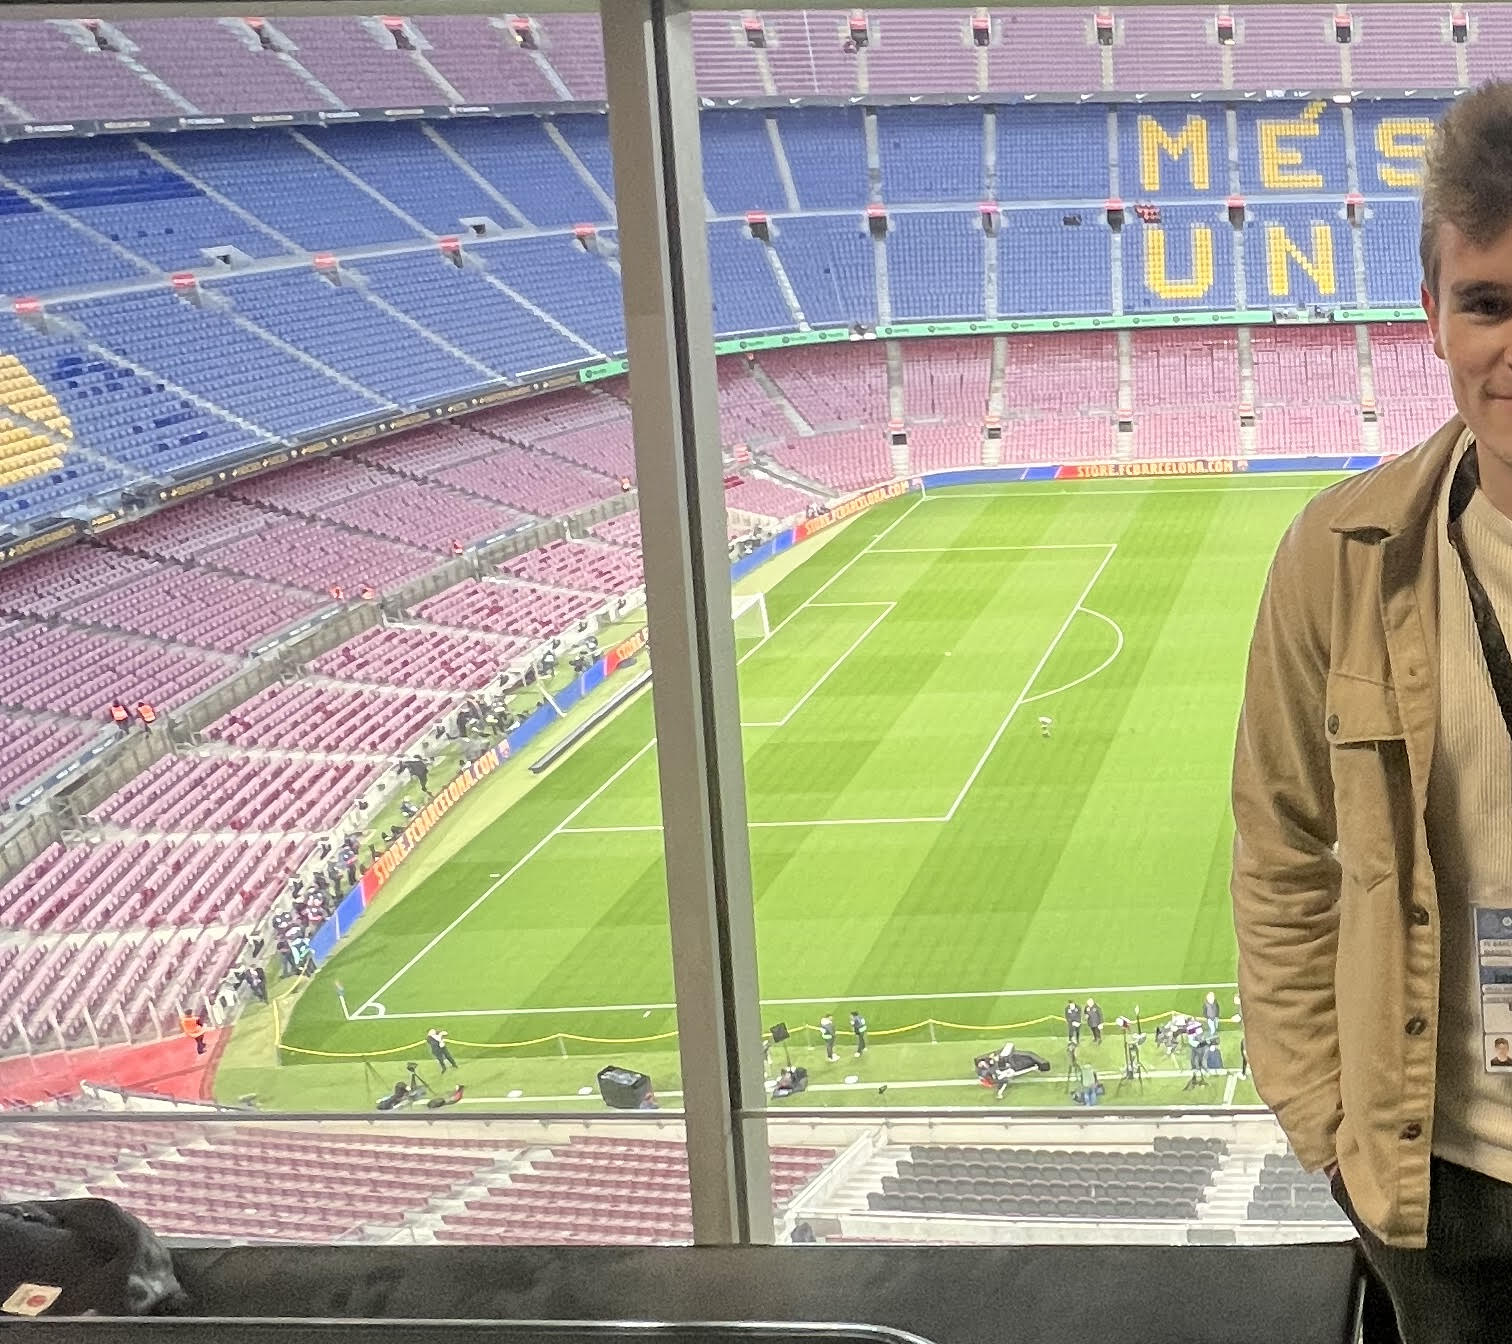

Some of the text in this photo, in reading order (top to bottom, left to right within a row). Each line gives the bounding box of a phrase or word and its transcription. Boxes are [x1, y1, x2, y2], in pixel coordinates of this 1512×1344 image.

[1138, 102, 1436, 191] MÉS
[1144, 220, 1336, 299] UN
[1077, 460, 1233, 478] STORE.FCBARCELONA.COM
